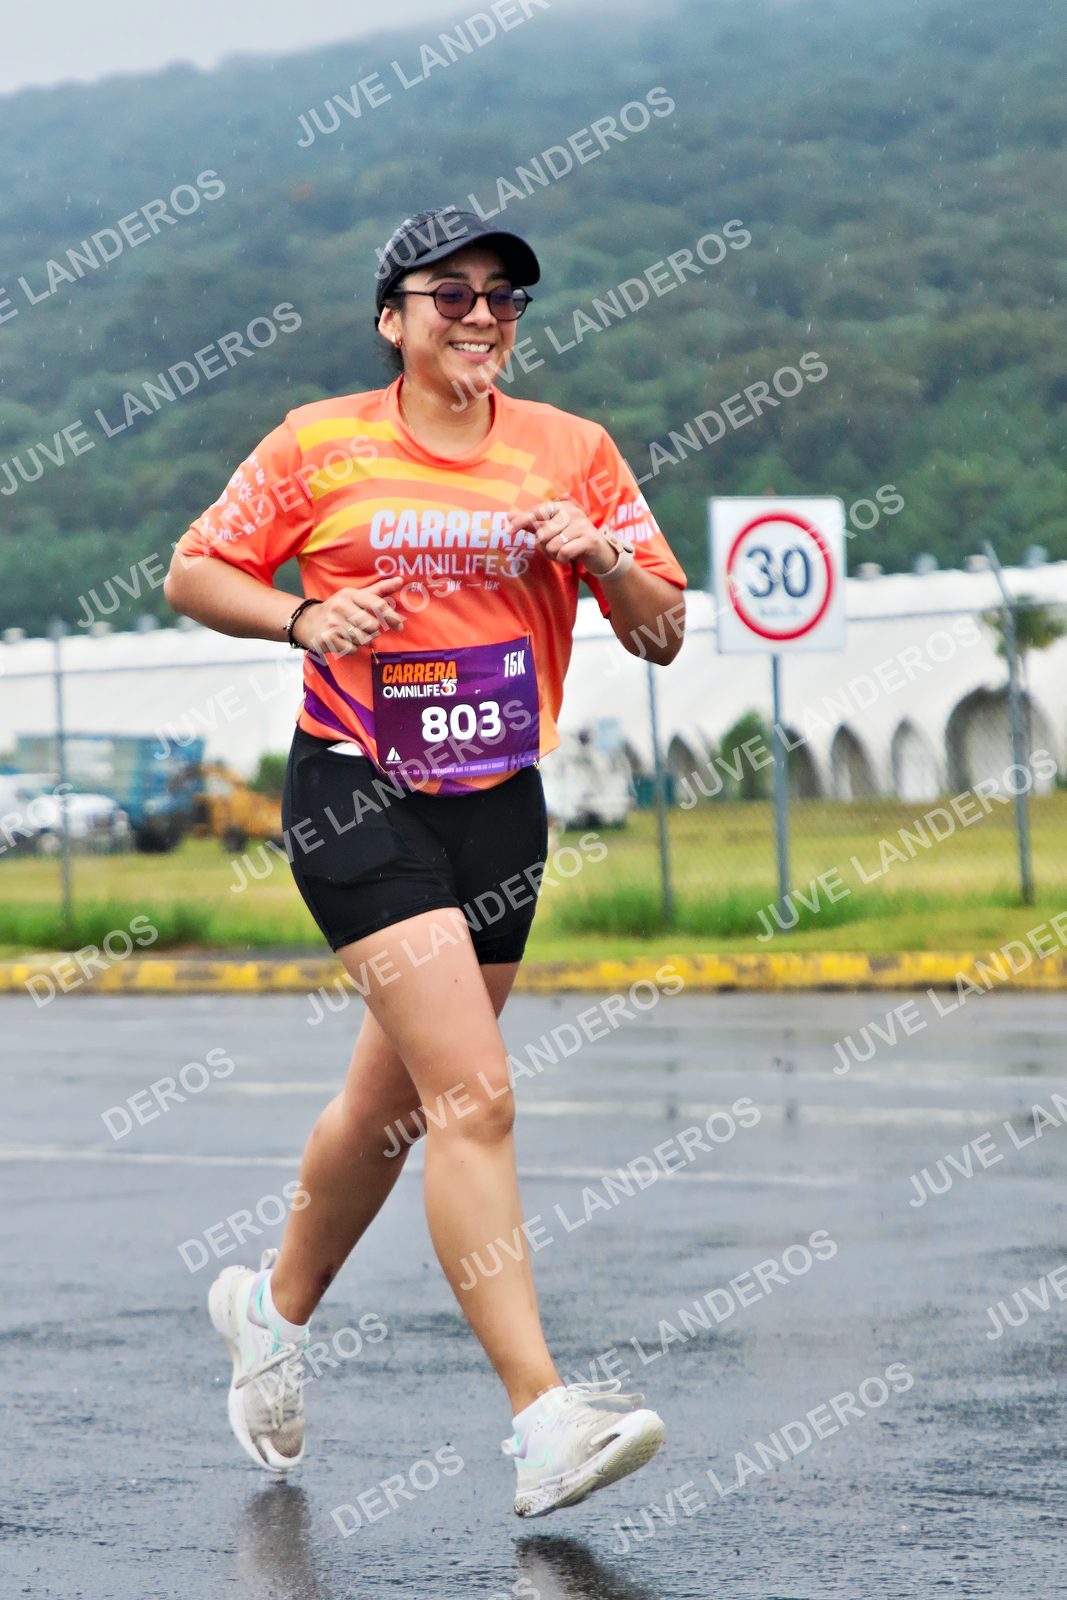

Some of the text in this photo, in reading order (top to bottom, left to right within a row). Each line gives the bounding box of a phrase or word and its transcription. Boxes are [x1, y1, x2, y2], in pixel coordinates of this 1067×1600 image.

[375, 554, 499, 576] OMNILIFE
[747, 545, 812, 598] 30
[382, 661, 457, 684] CARRERA
[503, 650, 526, 678] 15K
[382, 684, 441, 698] OMNILIFE
[421, 701, 501, 743] 803
